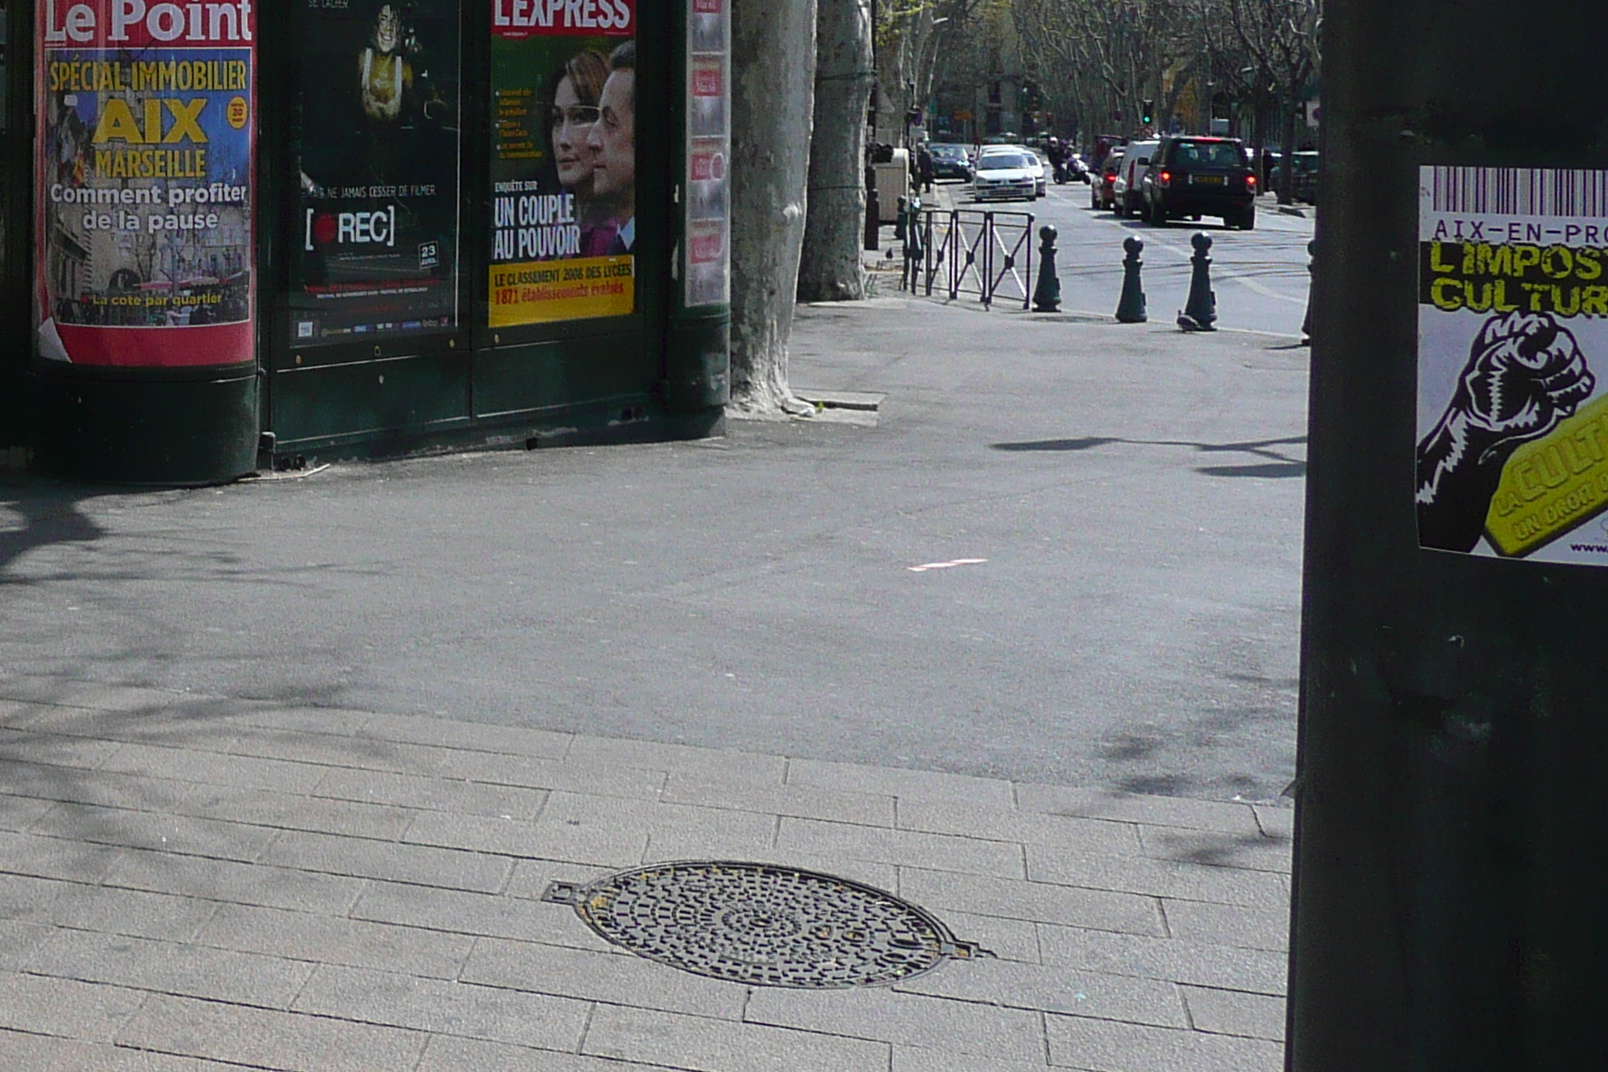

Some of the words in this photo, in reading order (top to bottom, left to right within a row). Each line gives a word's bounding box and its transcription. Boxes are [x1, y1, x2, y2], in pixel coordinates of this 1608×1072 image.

[49, 55, 125, 92] SPÉCIAL
[131, 59, 247, 92] IMMOBILIER
[91, 98, 209, 144] AIX
[95, 149, 207, 178] MARSEILLE
[50, 183, 162, 205] Comment
[168, 182, 248, 207] profiter
[340, 186, 368, 199] JAMAIS
[368, 185, 397, 199] CESSER
[398, 184, 409, 197] DE
[410, 183, 437, 197] FILMER
[524, 180, 538, 191] SUR
[83, 211, 112, 230] de
[118, 211, 141, 230] la
[148, 211, 219, 234] pause
[494, 196, 515, 228] UN
[518, 194, 575, 226] COUPLE
[421, 244, 436, 259] 23
[494, 228, 513, 260] AU
[518, 225, 581, 258] POUVOIR
[495, 273, 505, 287] LE
[507, 269, 560, 286] CLASSEMENT
[585, 265, 602, 279] DES
[92, 294, 109, 306] La
[111, 294, 142, 306] cote
[145, 295, 170, 307] par
[172, 293, 223, 307] quartier
[494, 288, 519, 305] 1871
[1512, 412, 1608, 503] CULT
